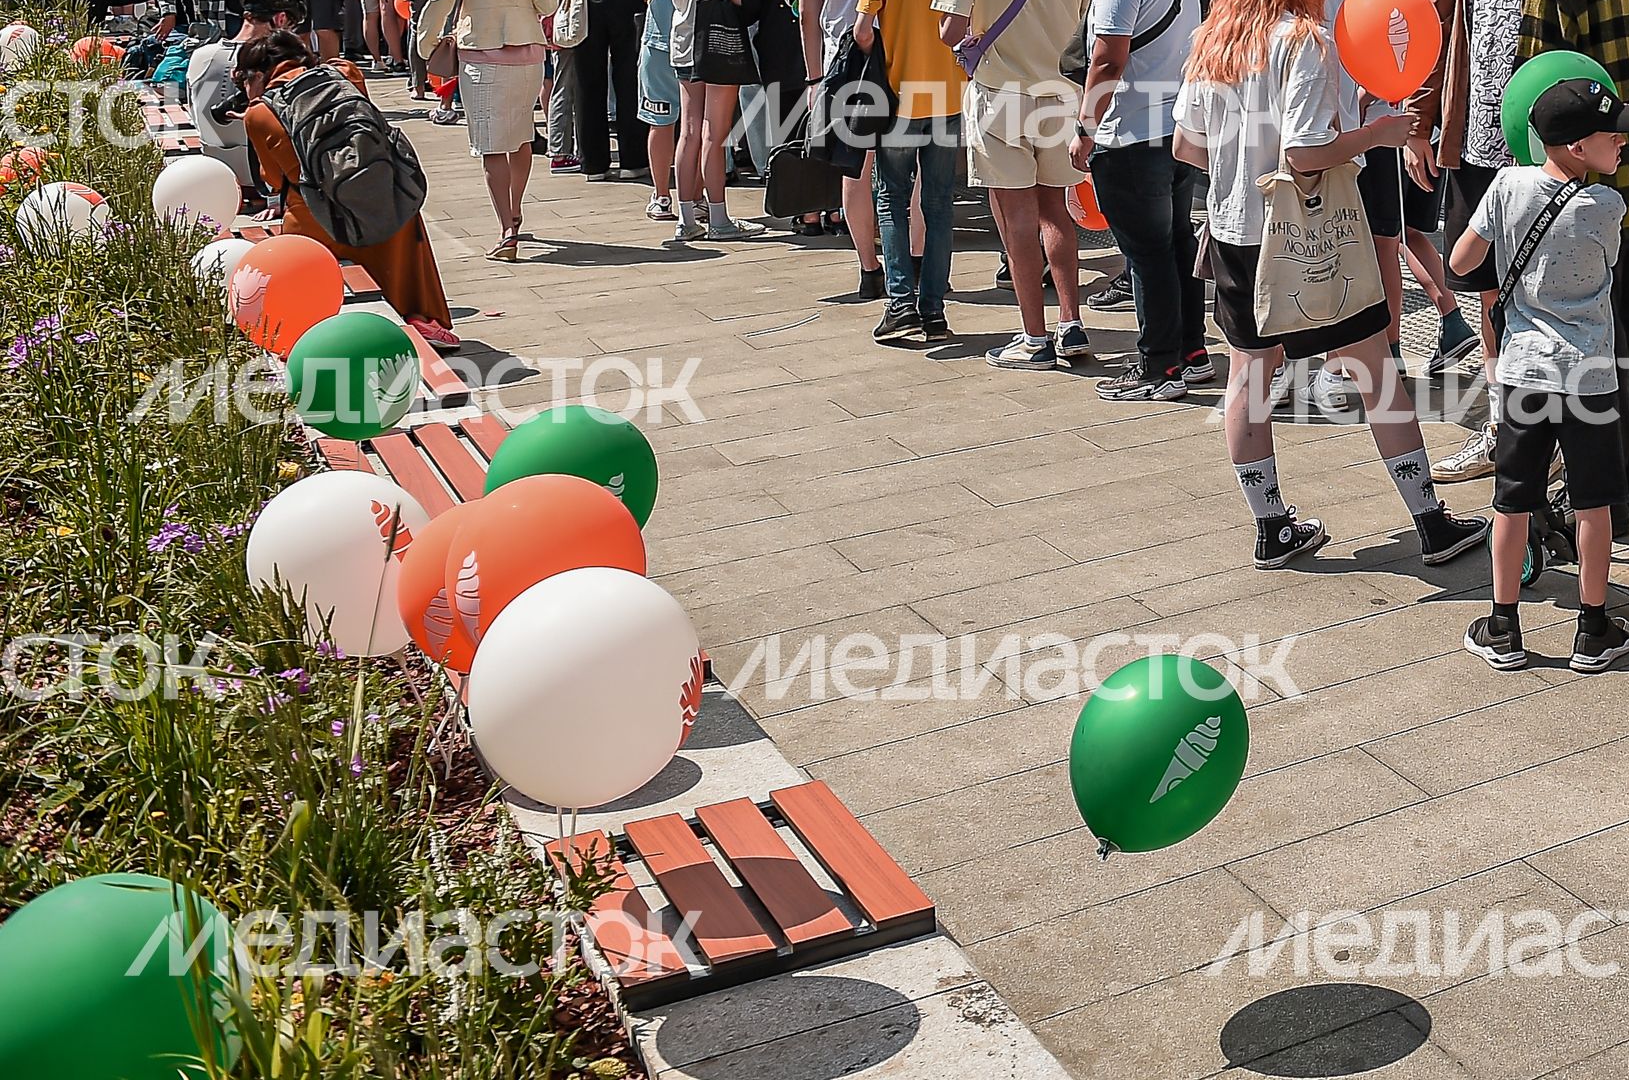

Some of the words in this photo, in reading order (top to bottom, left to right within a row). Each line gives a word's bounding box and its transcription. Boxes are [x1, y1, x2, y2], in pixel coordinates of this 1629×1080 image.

[1514, 238, 1535, 270] FUTURE
[1529, 230, 1540, 242] IS
[1537, 209, 1553, 233] NOW
